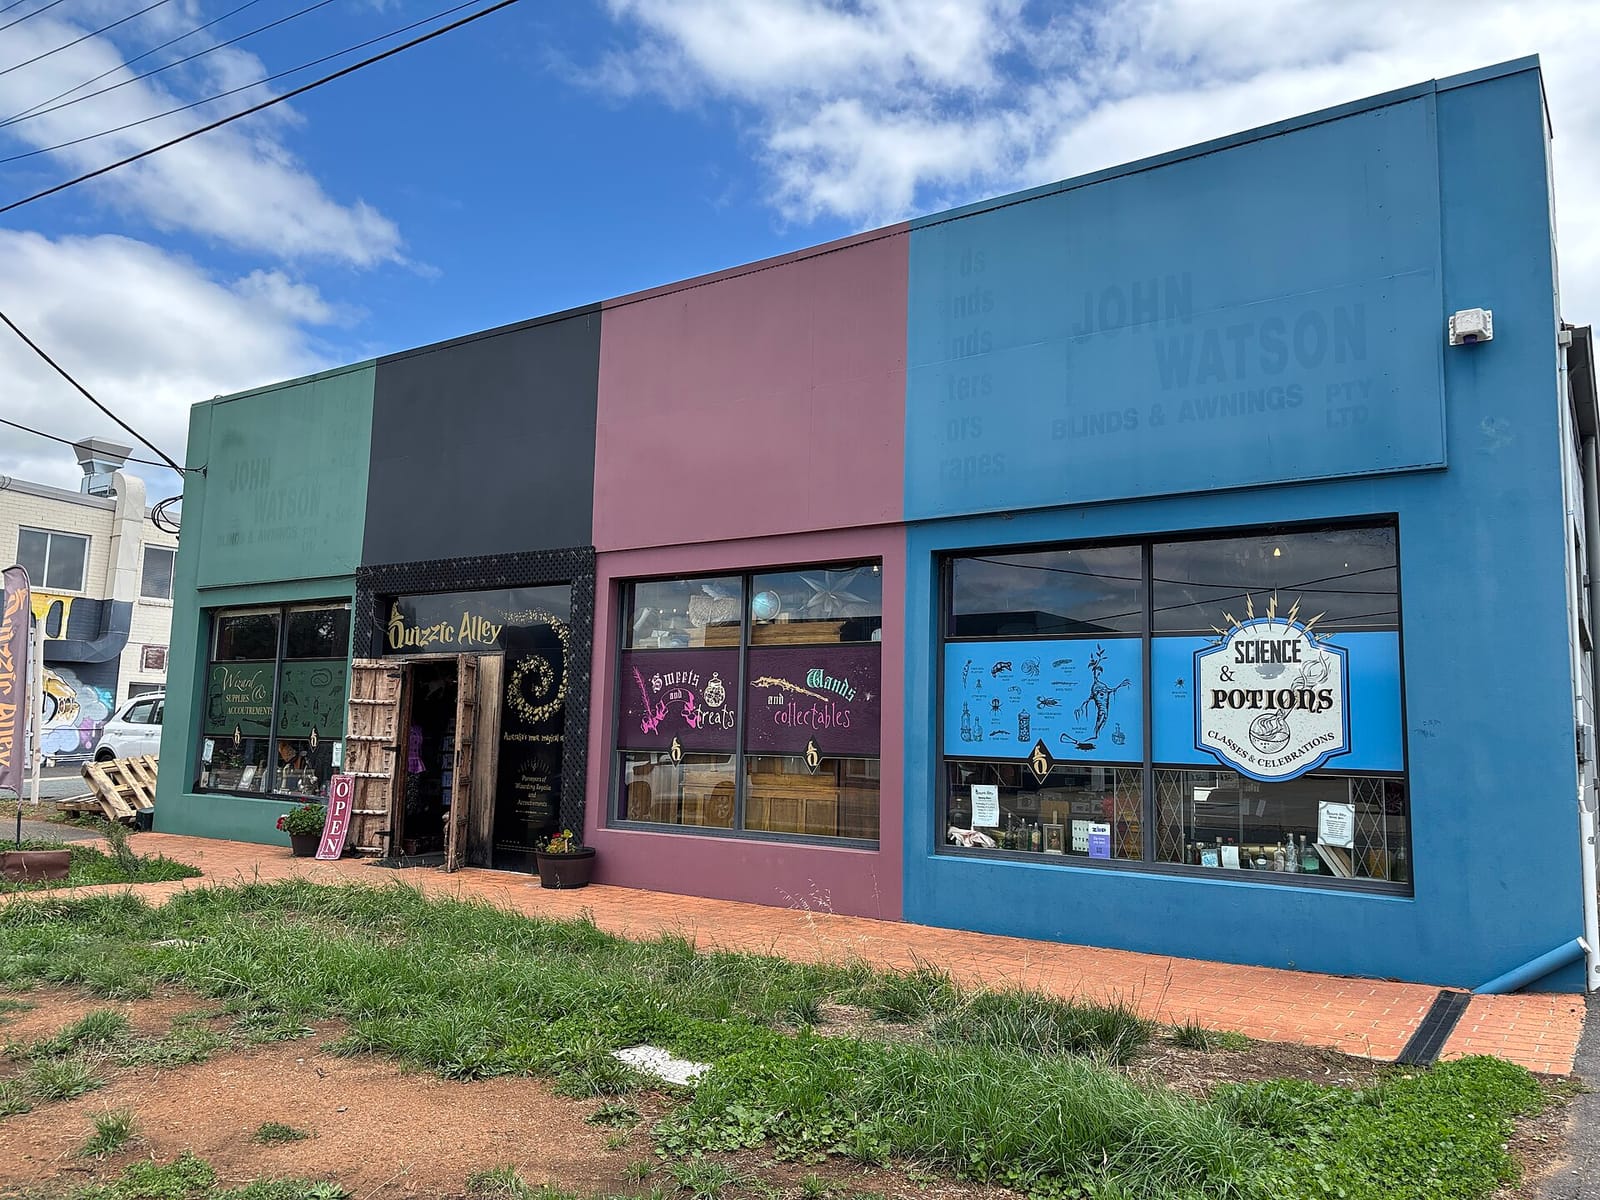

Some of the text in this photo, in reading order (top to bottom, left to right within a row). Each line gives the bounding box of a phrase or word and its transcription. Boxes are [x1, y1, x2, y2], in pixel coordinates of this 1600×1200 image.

[1071, 272, 1193, 343] JOHN
[1154, 303, 1368, 391] WATSON
[1051, 378, 1373, 441] BLINDS & AWNINGS PTY
[1325, 404, 1370, 430] LTD
[229, 457, 271, 493] JOHN
[254, 488, 321, 523] WATSON
[388, 603, 502, 649] Quizzic Alley
[1234, 639, 1301, 664] SCIENCE
[214, 666, 263, 691] Wizard
[650, 670, 700, 693] Sweets
[806, 668, 857, 702] Wands
[1219, 665, 1236, 682] &
[225, 694, 249, 703] SUPPLIES
[669, 688, 682, 699] and
[767, 694, 783, 705] and
[1209, 688, 1333, 713] POTIONS
[696, 704, 734, 729] treats
[774, 703, 850, 729] collectables
[1207, 730, 1335, 768] CLASSES & CELEBRATIONS
[324, 782, 349, 853] OPEN
